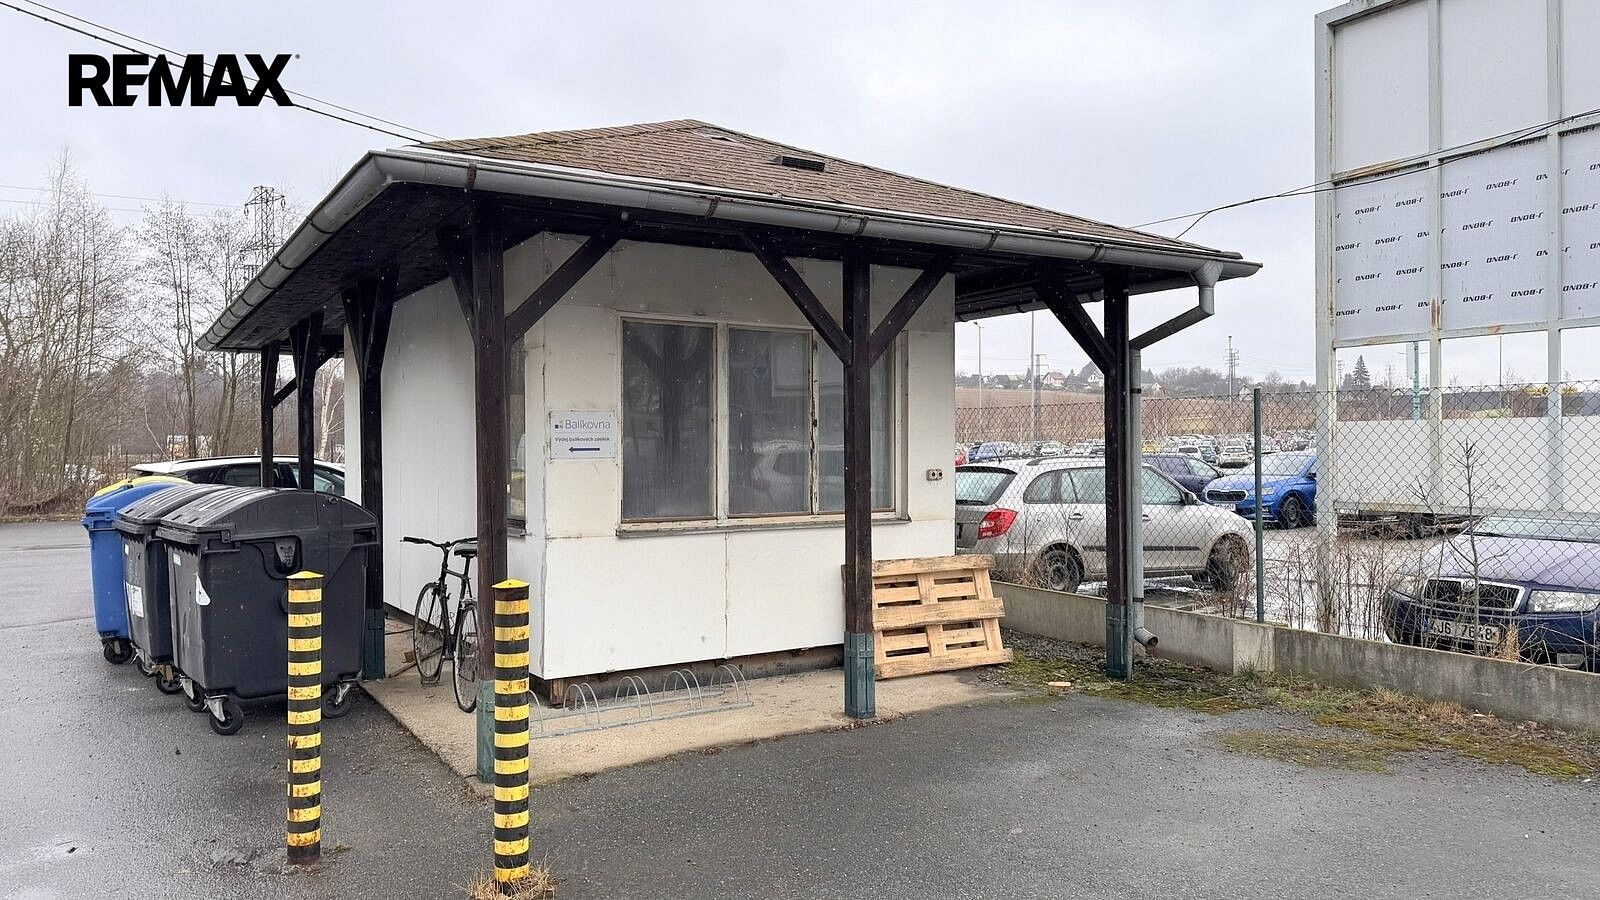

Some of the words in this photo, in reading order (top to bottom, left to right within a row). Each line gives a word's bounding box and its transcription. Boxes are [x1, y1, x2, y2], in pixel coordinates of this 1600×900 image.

[1486, 179, 1518, 190] J-BOND
[1395, 197, 1424, 208] J-BOND
[1355, 206, 1381, 215] J-BOND
[1562, 203, 1599, 215] J-BOND
[1510, 212, 1543, 223] J-BOND
[1462, 220, 1493, 231] J-BOND
[1375, 236, 1402, 245] J-BOND
[1335, 243, 1361, 252] J-BOND
[1486, 254, 1518, 264] J-BOND
[1396, 267, 1424, 276] J-BOND
[1355, 273, 1382, 282] J-BOND
[1562, 282, 1598, 292] J-BOND
[1510, 288, 1544, 298] J-BOND
[1462, 294, 1494, 303] J-BOND
[1336, 309, 1361, 317] J-BOND
[1375, 304, 1403, 313] J-BOND
